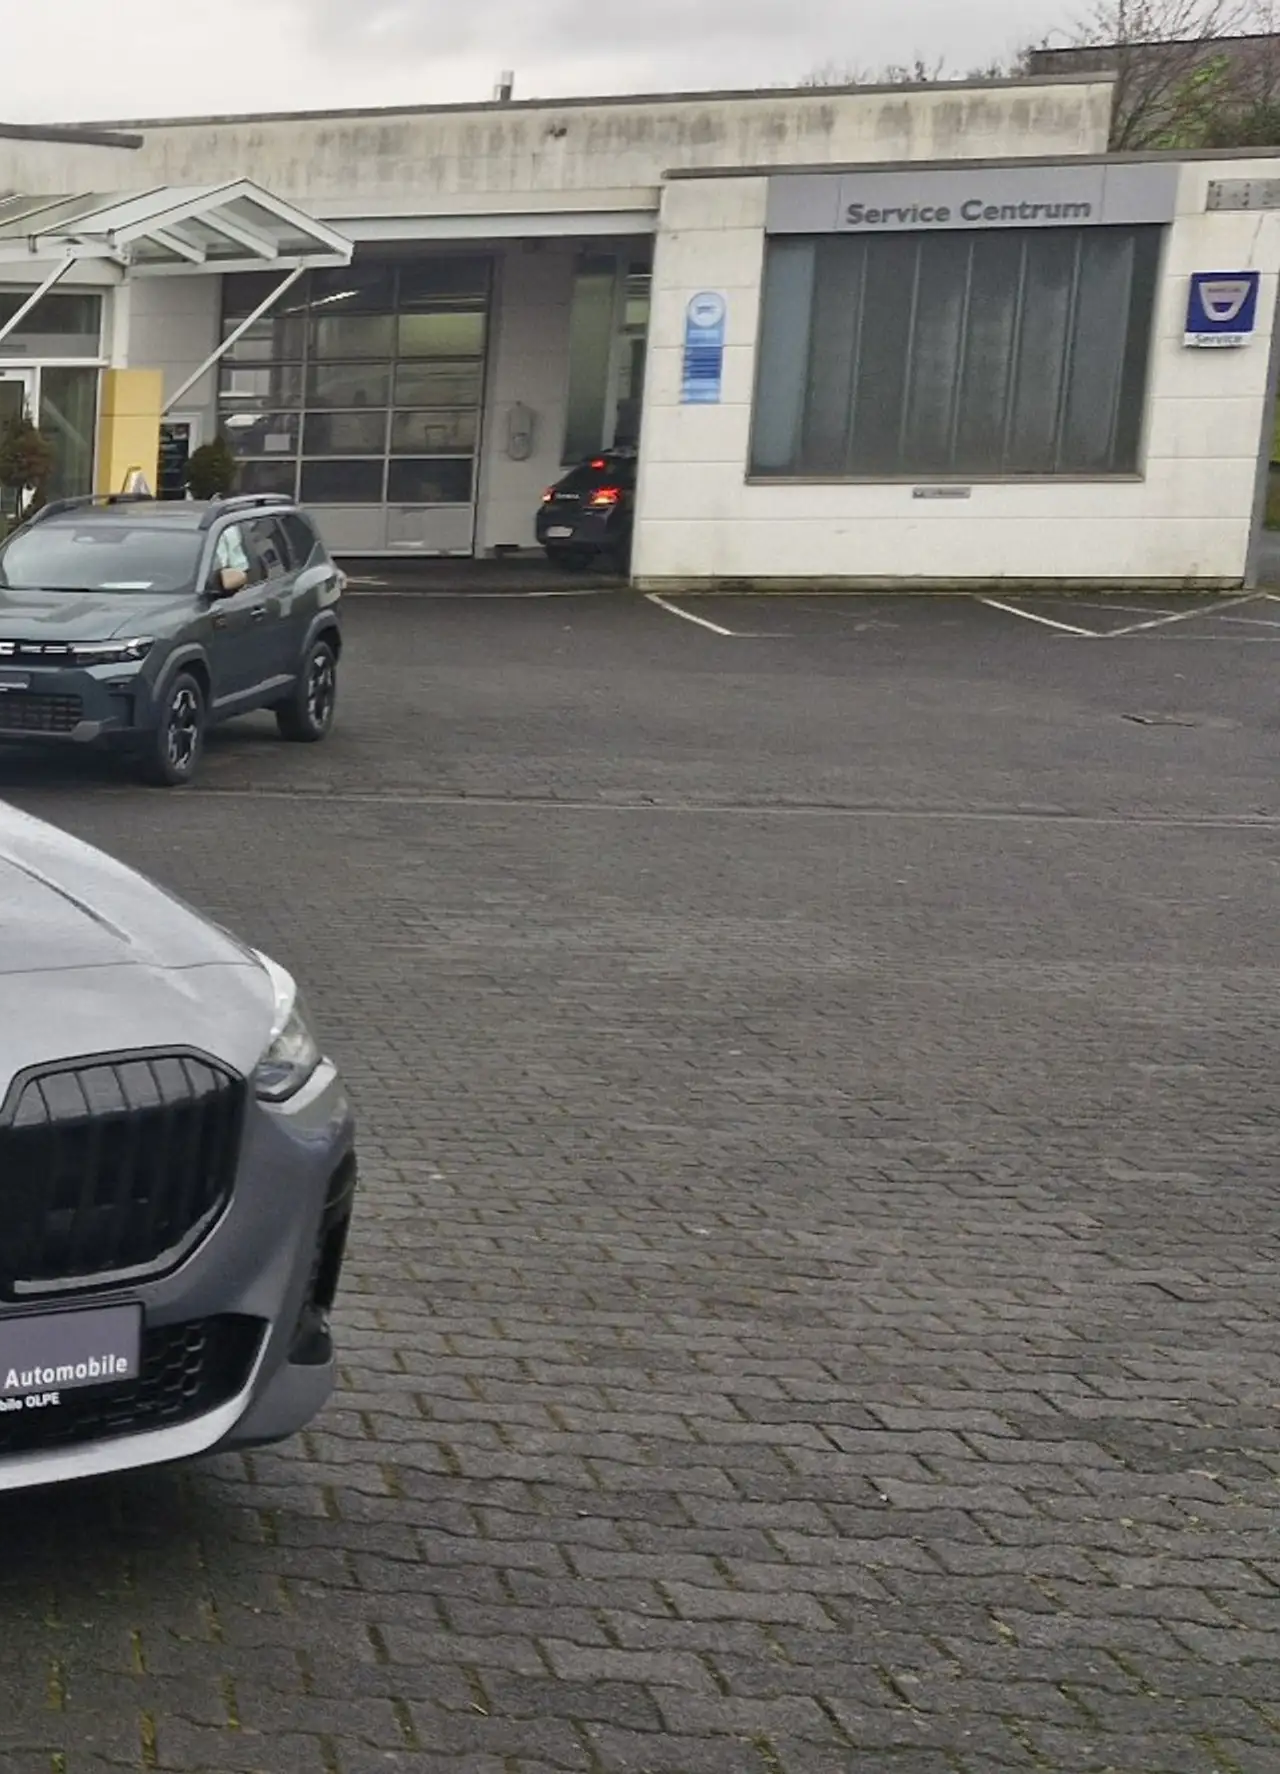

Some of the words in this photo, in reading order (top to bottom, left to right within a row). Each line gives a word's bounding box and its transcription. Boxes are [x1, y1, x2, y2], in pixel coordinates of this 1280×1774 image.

[846, 203, 950, 225] Service
[960, 199, 1092, 221] Centrum
[4, 1353, 129, 1389] Automobile
[25, 1391, 60, 1409] OLPE
